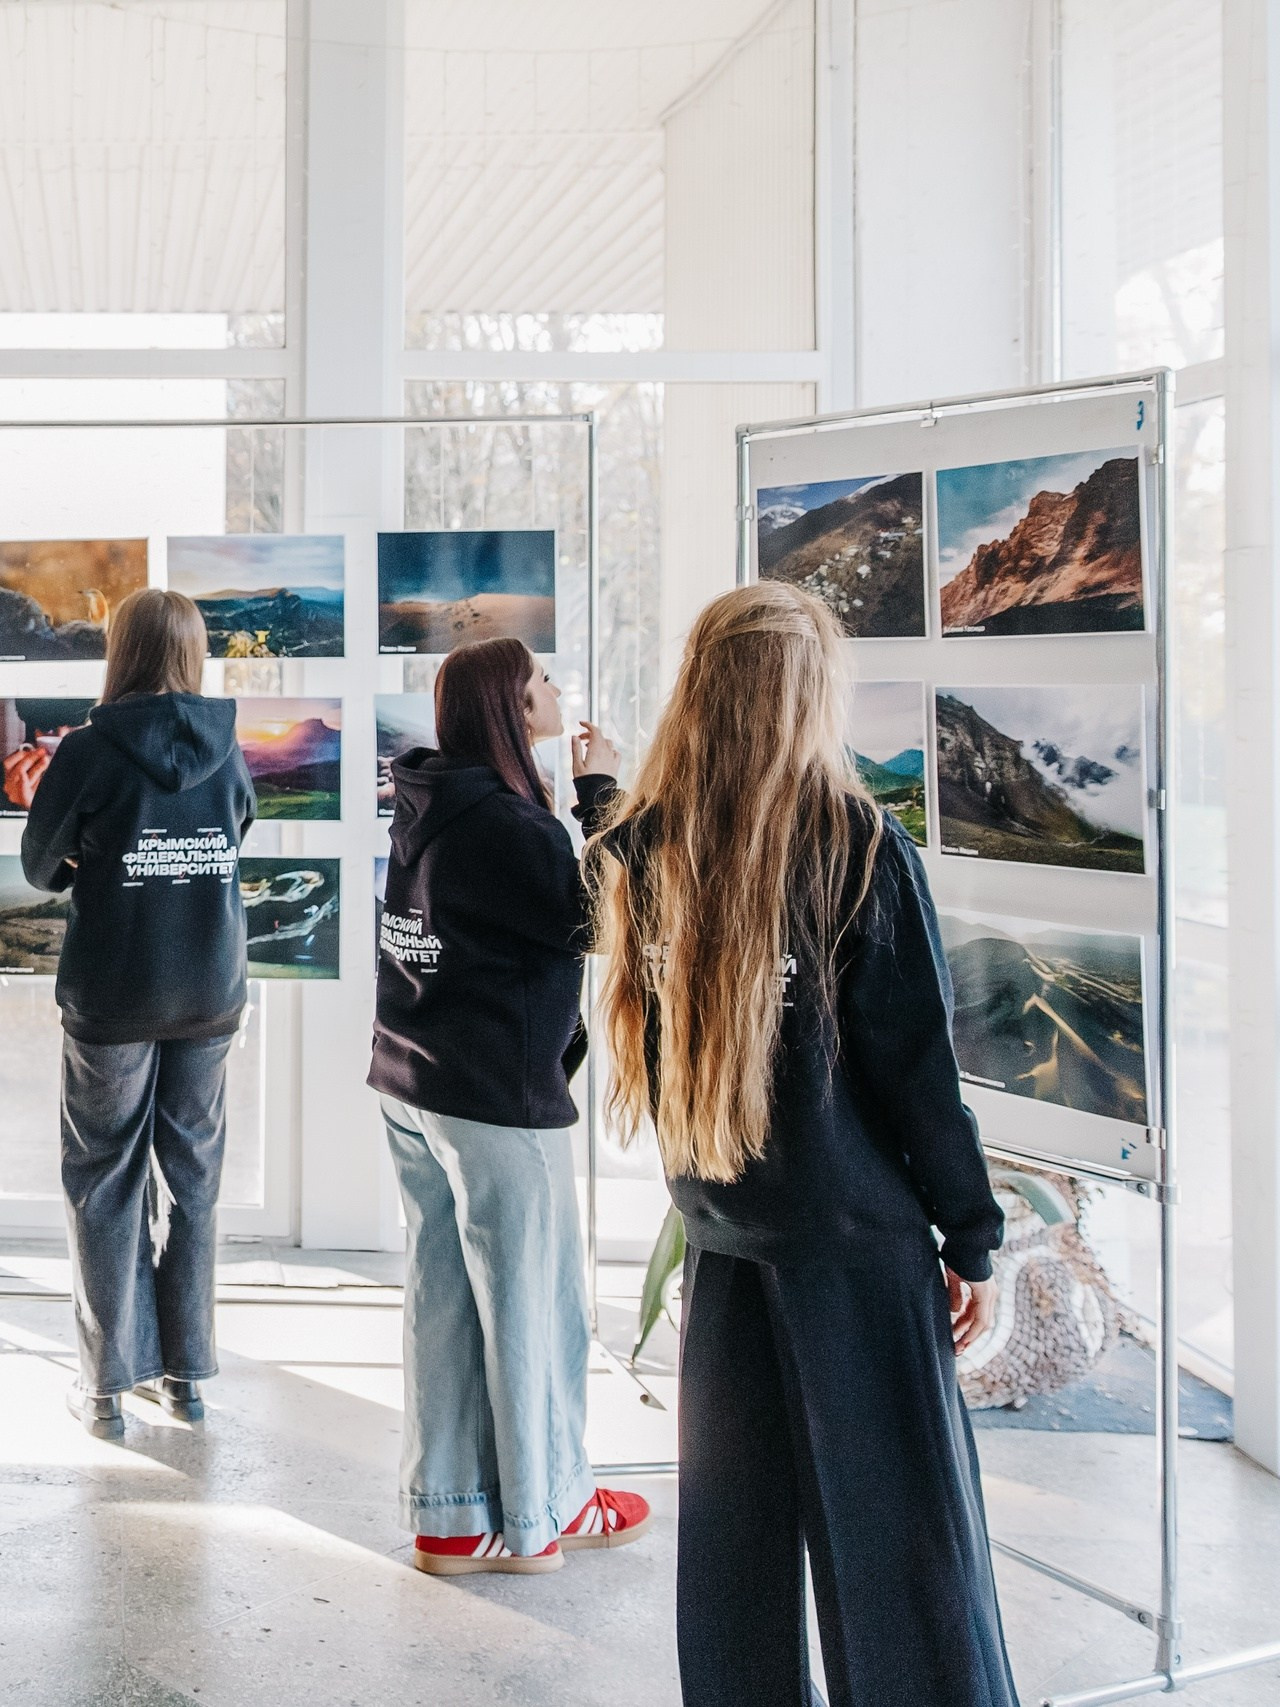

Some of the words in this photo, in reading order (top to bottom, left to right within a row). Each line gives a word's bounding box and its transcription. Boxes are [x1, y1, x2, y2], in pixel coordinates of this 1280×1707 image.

[137, 834, 228, 851] КРЫМСКИЙ
[121, 845, 238, 864] ФЕДЕРАЛЬНЫЙ
[125, 861, 235, 877] УНИВЕРСИТЕТ
